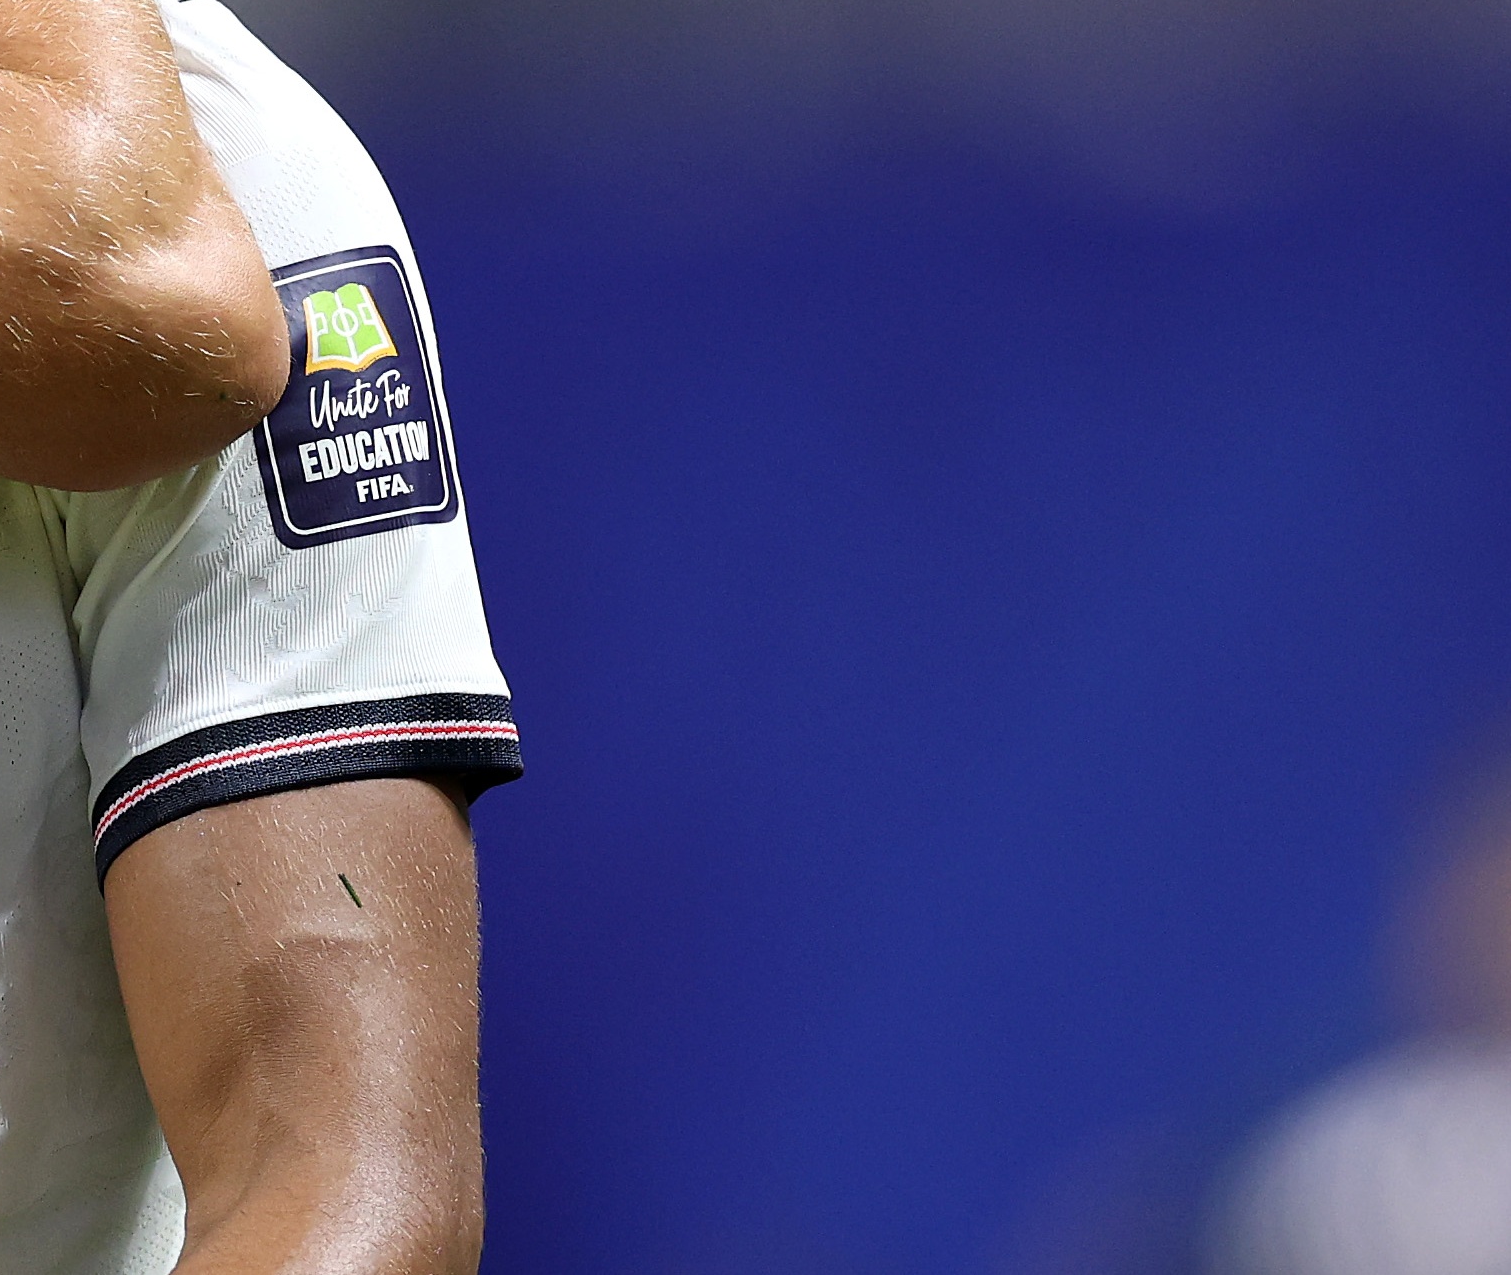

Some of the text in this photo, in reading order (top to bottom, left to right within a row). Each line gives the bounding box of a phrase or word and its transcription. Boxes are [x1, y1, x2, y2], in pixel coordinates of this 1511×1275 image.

[309, 369, 411, 432] Unite For
[298, 420, 430, 483] EDUCATION
[356, 473, 411, 503] FIFA
